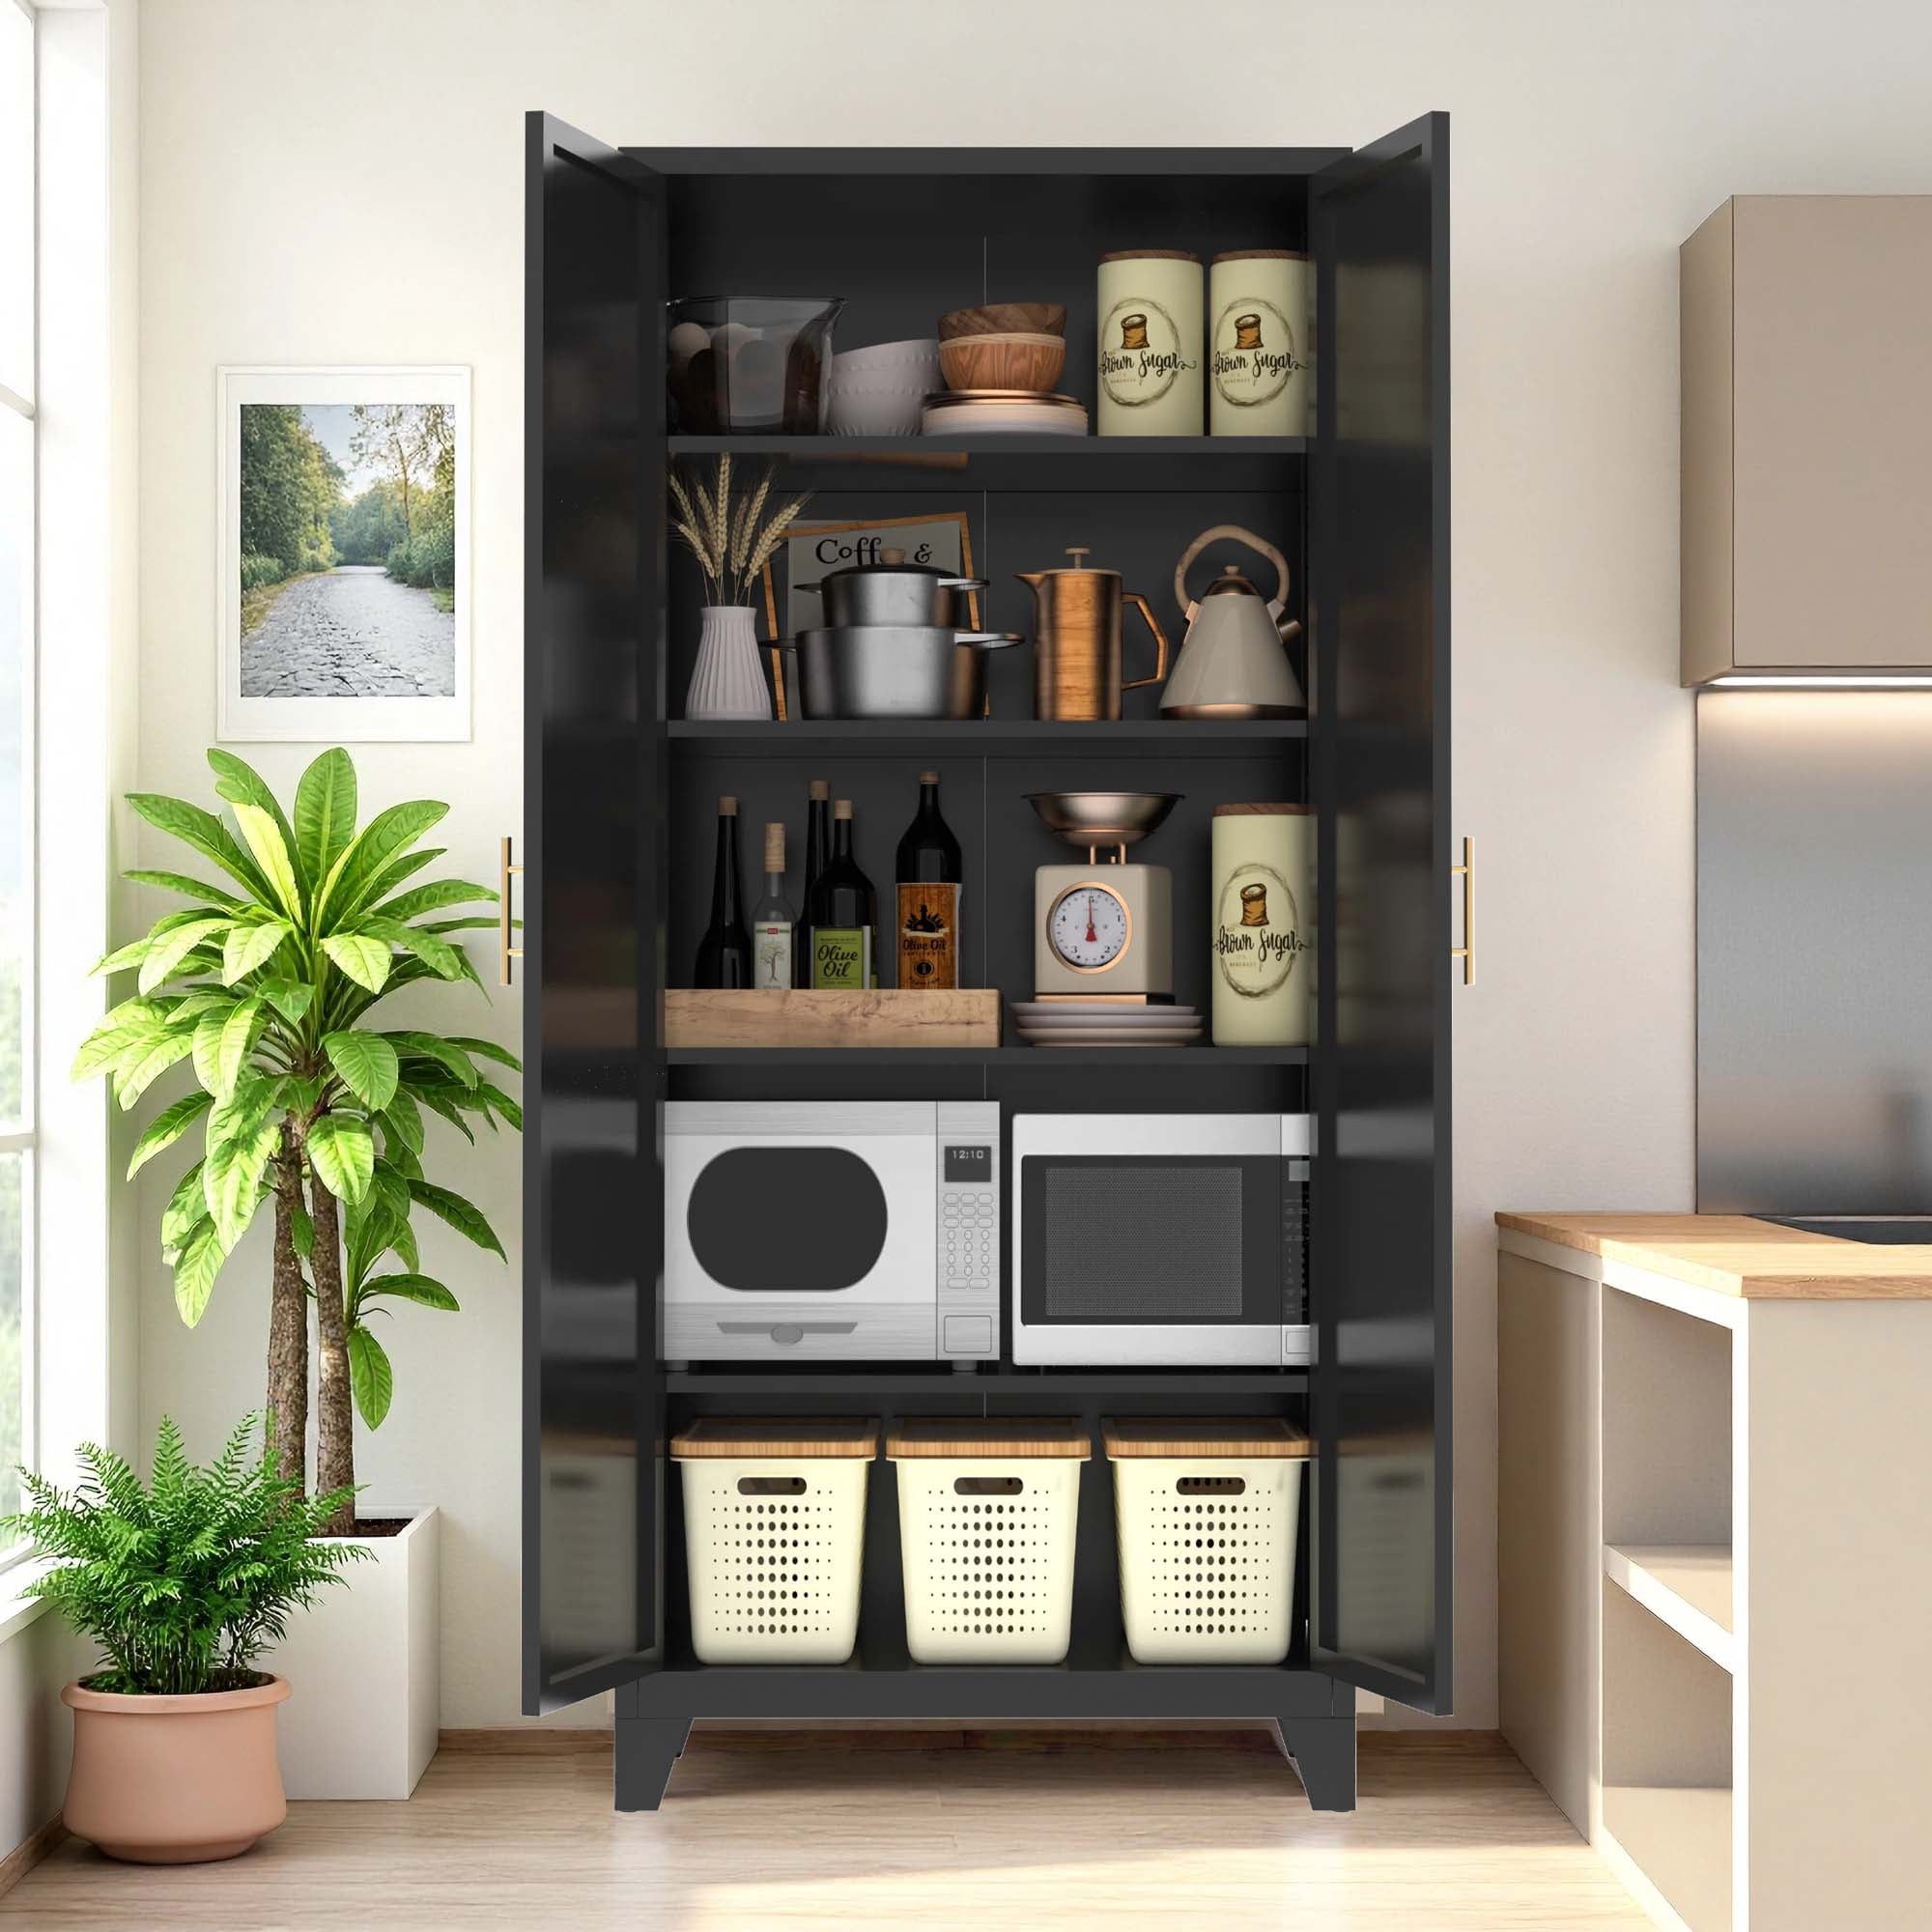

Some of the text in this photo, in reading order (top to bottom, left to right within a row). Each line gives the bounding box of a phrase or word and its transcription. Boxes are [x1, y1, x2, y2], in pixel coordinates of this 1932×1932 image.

[1138, 350, 1182, 379] Sugar
[1213, 350, 1296, 379] Brown Sugar
[815, 536, 933, 566] Coff &
[817, 944, 859, 961] Olive
[903, 939, 947, 951] Olive Oil
[1218, 924, 1299, 962] Brown Sugar
[823, 960, 851, 978] Oil
[952, 1150, 984, 1159] 12:10
